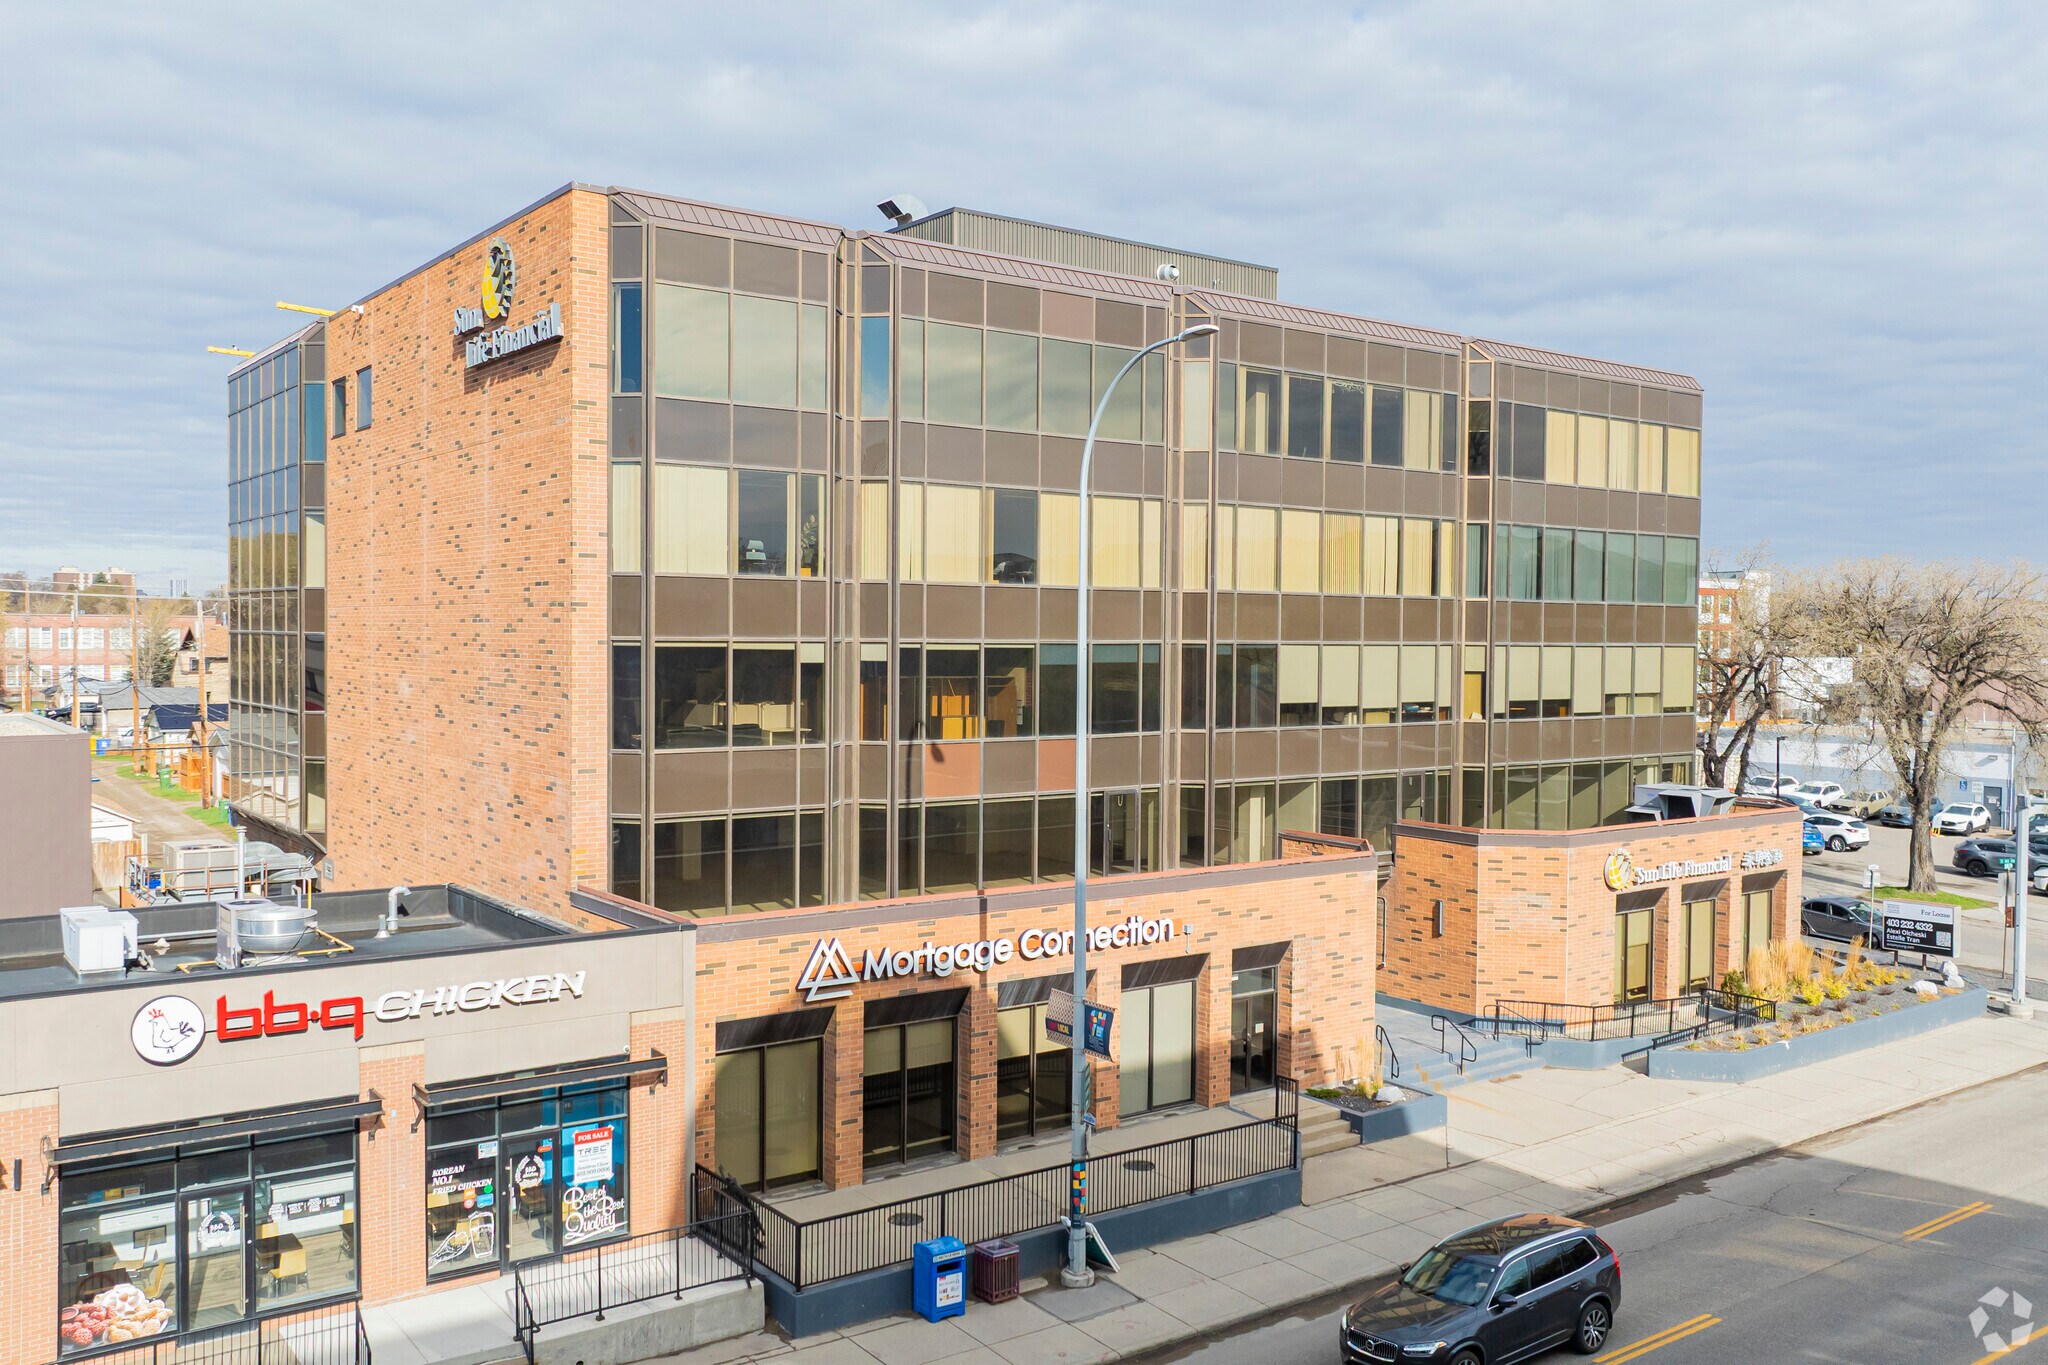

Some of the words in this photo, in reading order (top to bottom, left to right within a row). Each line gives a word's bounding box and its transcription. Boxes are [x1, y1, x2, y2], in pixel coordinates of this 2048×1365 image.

[454, 307, 484, 336] Sun
[492, 303, 563, 358] Financial
[1636, 866, 1659, 884] Sun
[1661, 861, 1682, 880] Life
[1684, 855, 1731, 876] Financial
[1886, 918, 1900, 927] 403
[1900, 920, 1914, 929] 232
[1915, 922, 1934, 932] 4332
[1920, 909, 1931, 917] For
[1932, 910, 1951, 919] Lease
[1901, 929, 1927, 938] Olcheski
[863, 941, 1014, 981] Mortgage
[1018, 916, 1175, 960] Connection
[374, 970, 587, 1024] CHICKEN
[577, 1134, 592, 1142] FOR
[592, 1130, 610, 1139] SALE
[432, 1165, 465, 1177] KOREAN
[432, 1175, 453, 1186] NO.1
[432, 1185, 456, 1196] FRIED
[458, 1178, 493, 1191] CHICKEN
[563, 1186, 598, 1210] Best
[597, 1184, 607, 1197] of
[583, 1203, 597, 1218] the
[596, 1196, 625, 1216] Best
[565, 1211, 616, 1240] Quality
